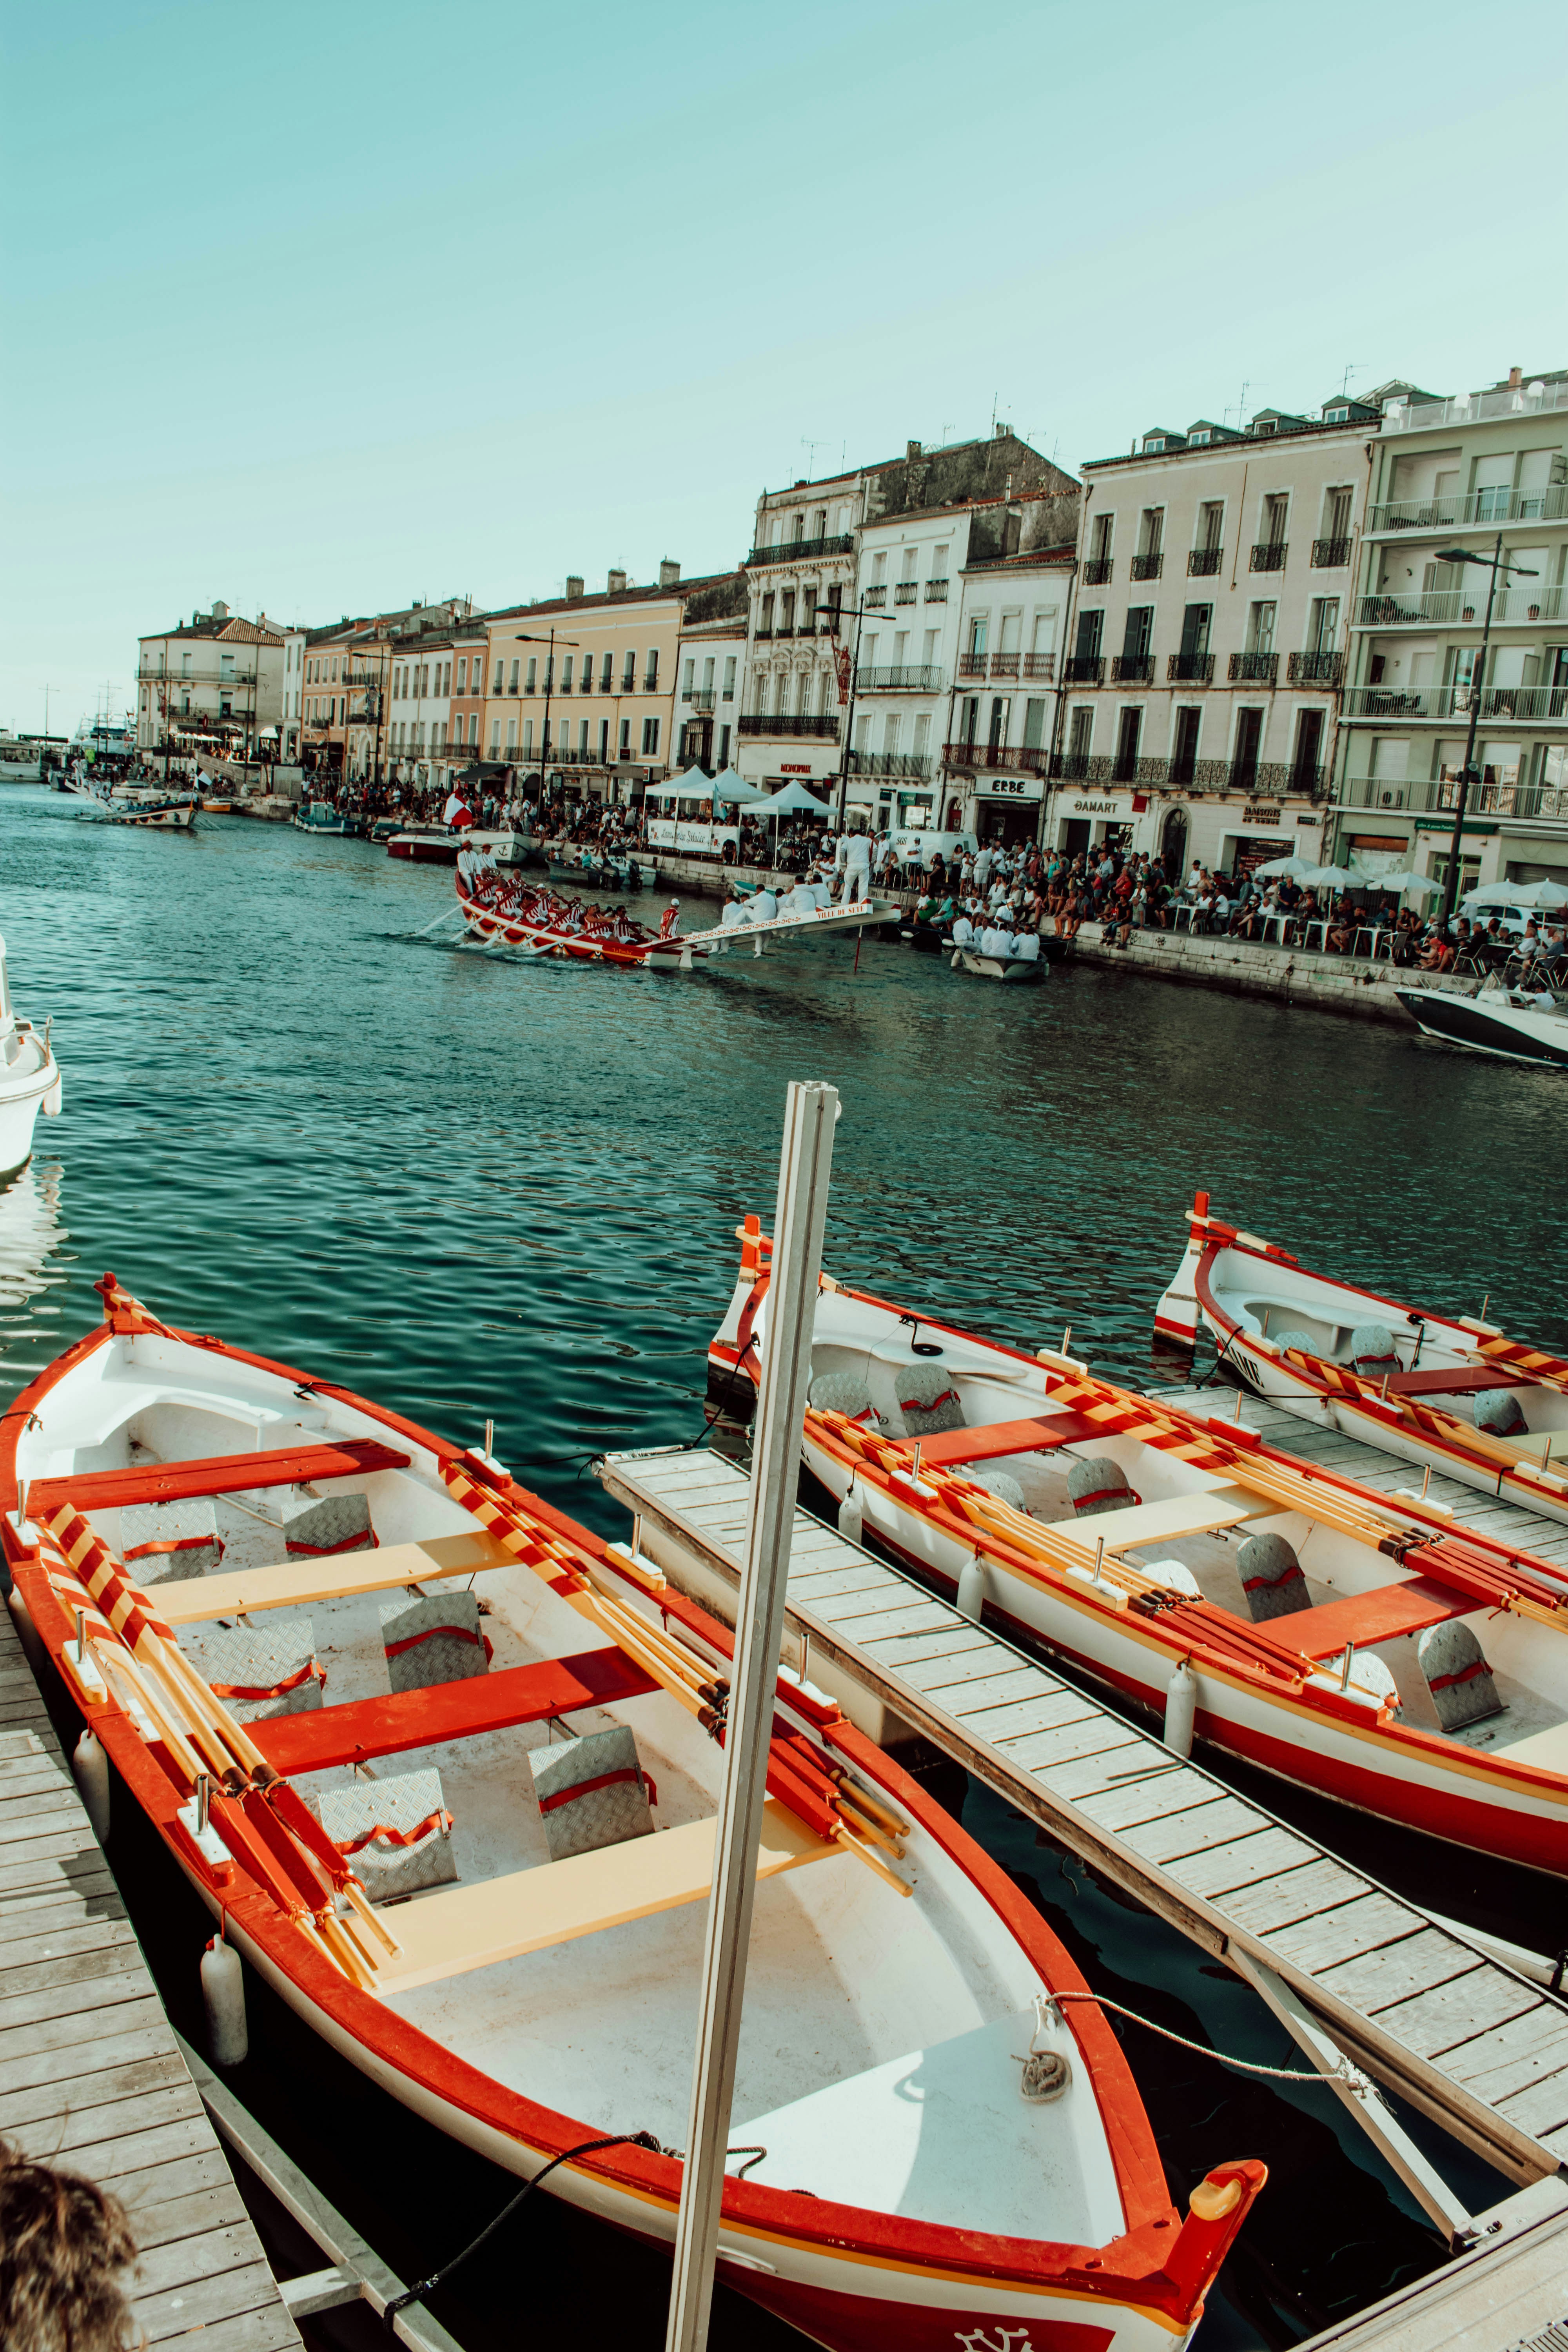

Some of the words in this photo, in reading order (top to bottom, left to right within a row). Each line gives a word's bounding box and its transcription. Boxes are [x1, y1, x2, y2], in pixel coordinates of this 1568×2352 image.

[780, 764, 811, 773] MONOPRIX
[992, 780, 1025, 794] ERBE
[1073, 800, 1118, 813] DAMART
[1243, 807, 1281, 817] MAISONS
[896, 837, 907, 846] SGS
[818, 910, 835, 919] VILLE
